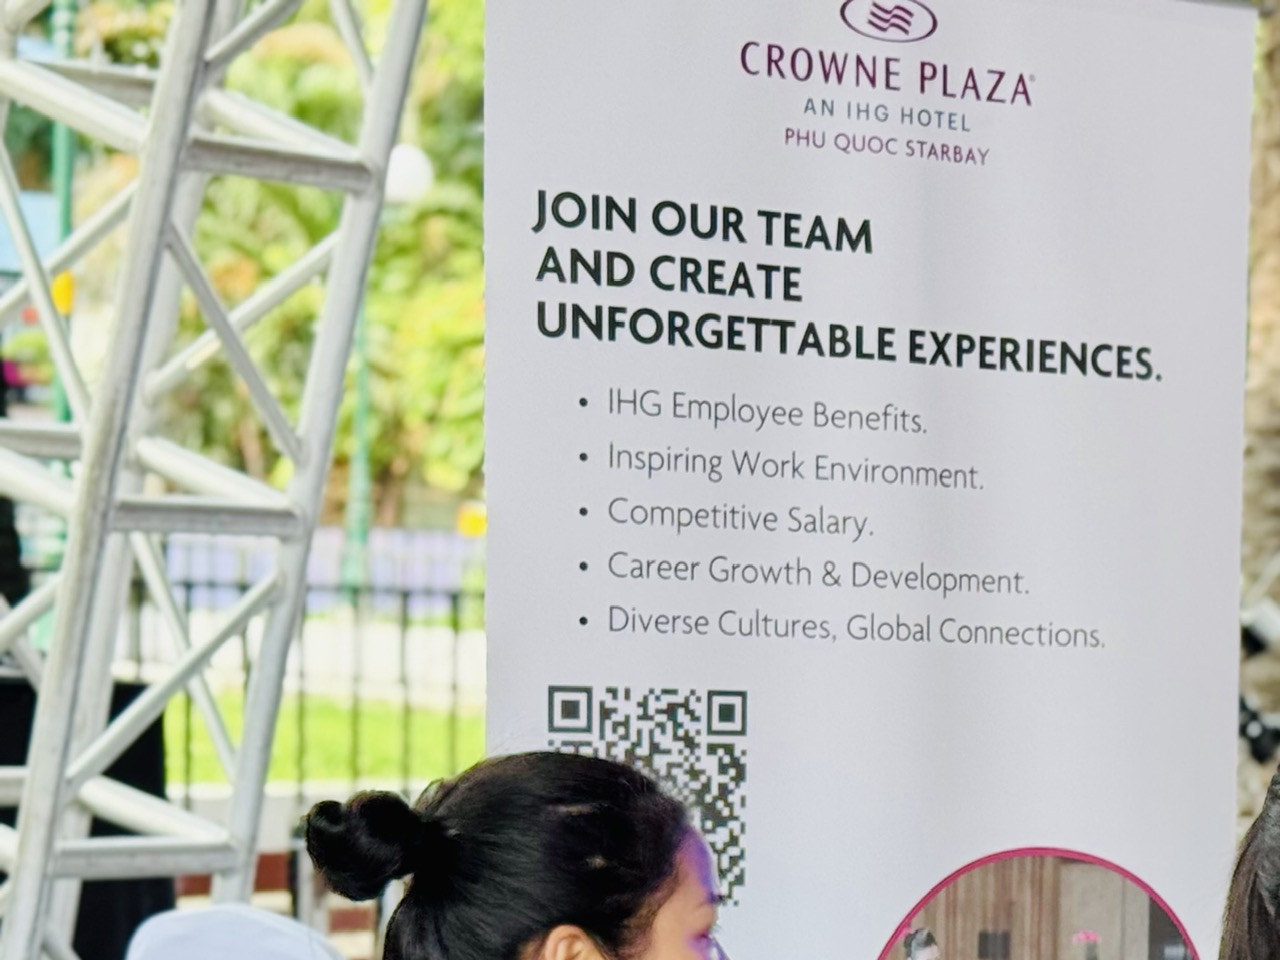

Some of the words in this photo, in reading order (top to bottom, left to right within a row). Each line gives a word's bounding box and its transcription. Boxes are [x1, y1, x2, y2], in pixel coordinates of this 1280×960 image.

[740, 41, 901, 91] CROWNE
[919, 60, 1032, 106] PLAZA
[803, 98, 835, 117] AN
[847, 101, 890, 123] IHG
[900, 106, 971, 132] HOTEL
[784, 128, 827, 149] PHU
[833, 132, 898, 156] QUOC
[905, 139, 990, 166] STARBAY
[532, 189, 637, 234] JOIN
[651, 200, 747, 244] OUR
[756, 209, 873, 254] TEAM
[535, 245, 636, 288] AND
[649, 254, 803, 303] CREATE
[537, 300, 897, 362] UNFORGETTABLE
[908, 329, 1162, 382] EXPERIENCES.
[608, 387, 662, 418] IHG
[672, 391, 804, 433] Employee
[813, 401, 928, 434] Benefits.
[608, 441, 723, 483] Inspiring
[731, 449, 805, 480] Work
[815, 454, 985, 491] Environment.
[608, 496, 779, 535] Competitive
[787, 504, 874, 543] Salary.
[608, 550, 701, 582] Career
[708, 555, 812, 587] Growth
[821, 560, 842, 587] &
[851, 561, 1031, 600] Development.
[608, 604, 710, 636] Diverse
[718, 608, 837, 644] Cultures,
[846, 612, 932, 644] Global
[939, 617, 1106, 650] Connections.
